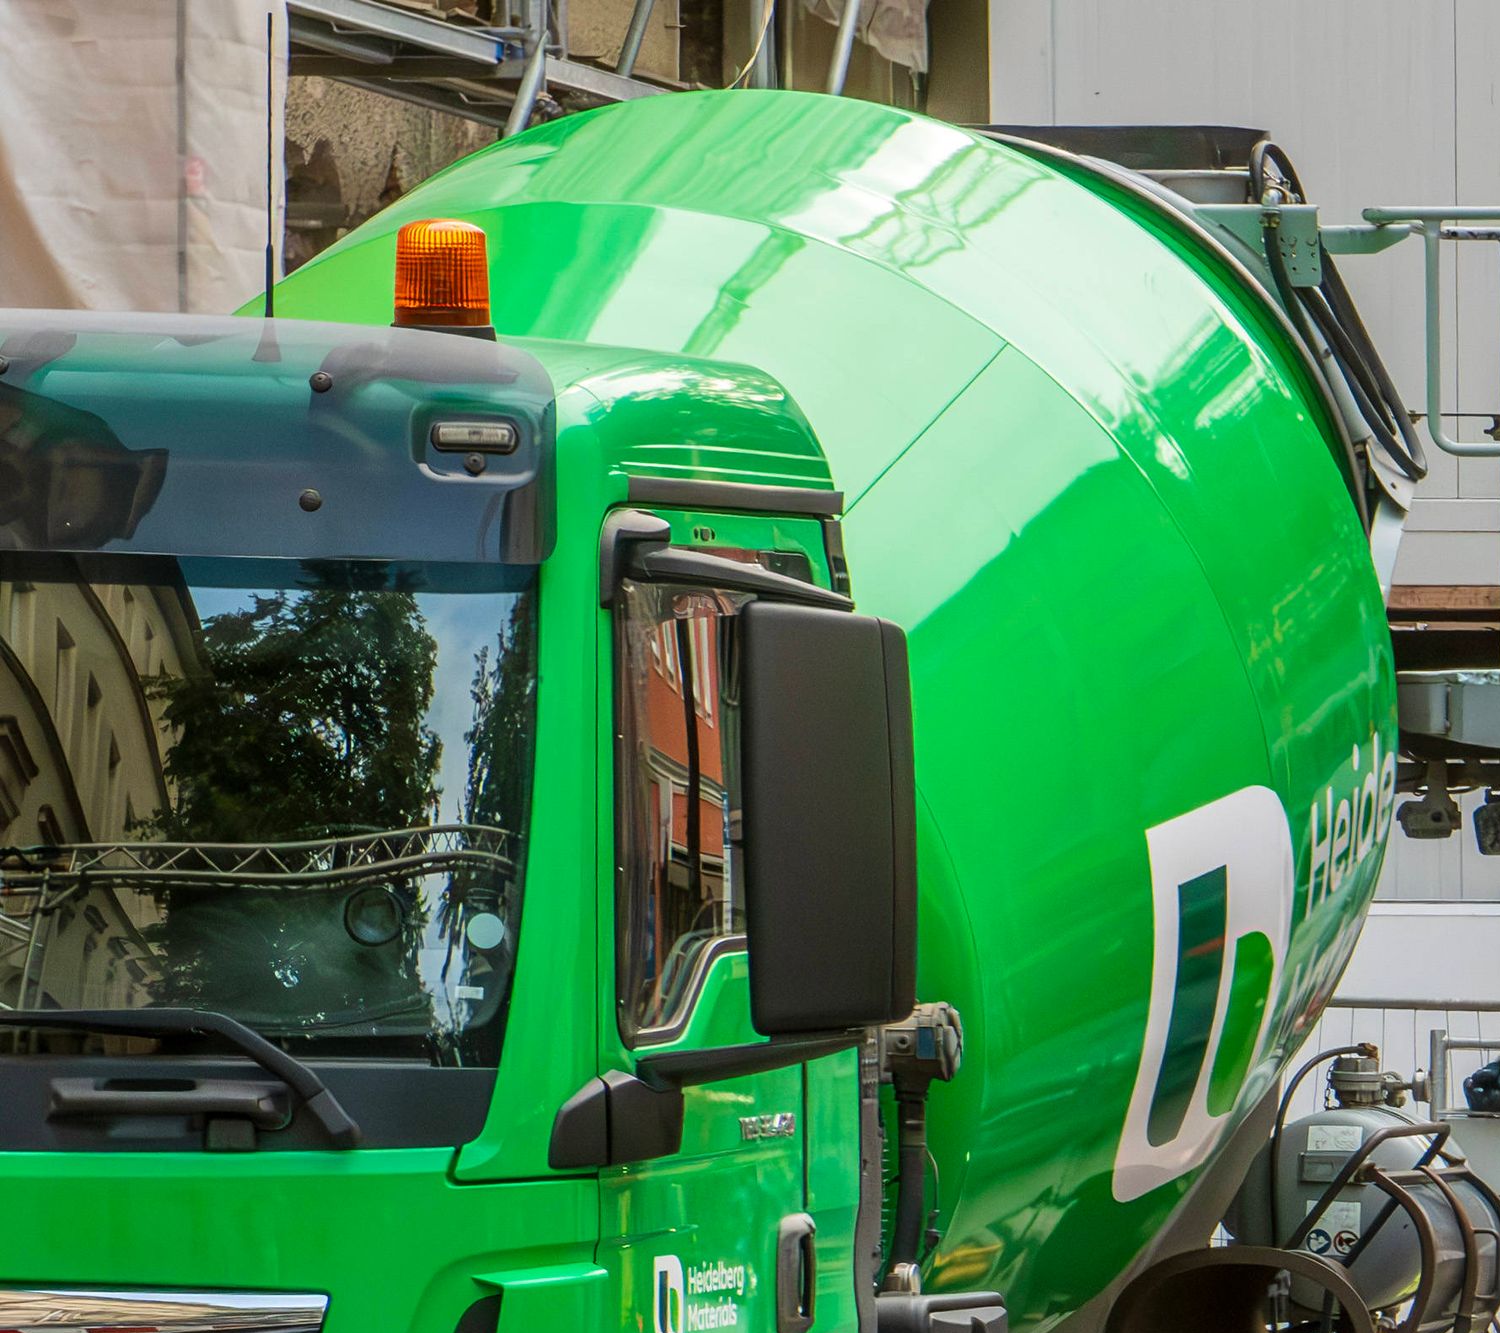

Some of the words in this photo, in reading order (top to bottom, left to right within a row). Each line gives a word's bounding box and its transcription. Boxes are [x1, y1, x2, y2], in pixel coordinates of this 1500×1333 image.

[1305, 731, 1395, 921] Heide
[688, 1261, 744, 1295] Heidelberg
[688, 1296, 738, 1331] Materials
